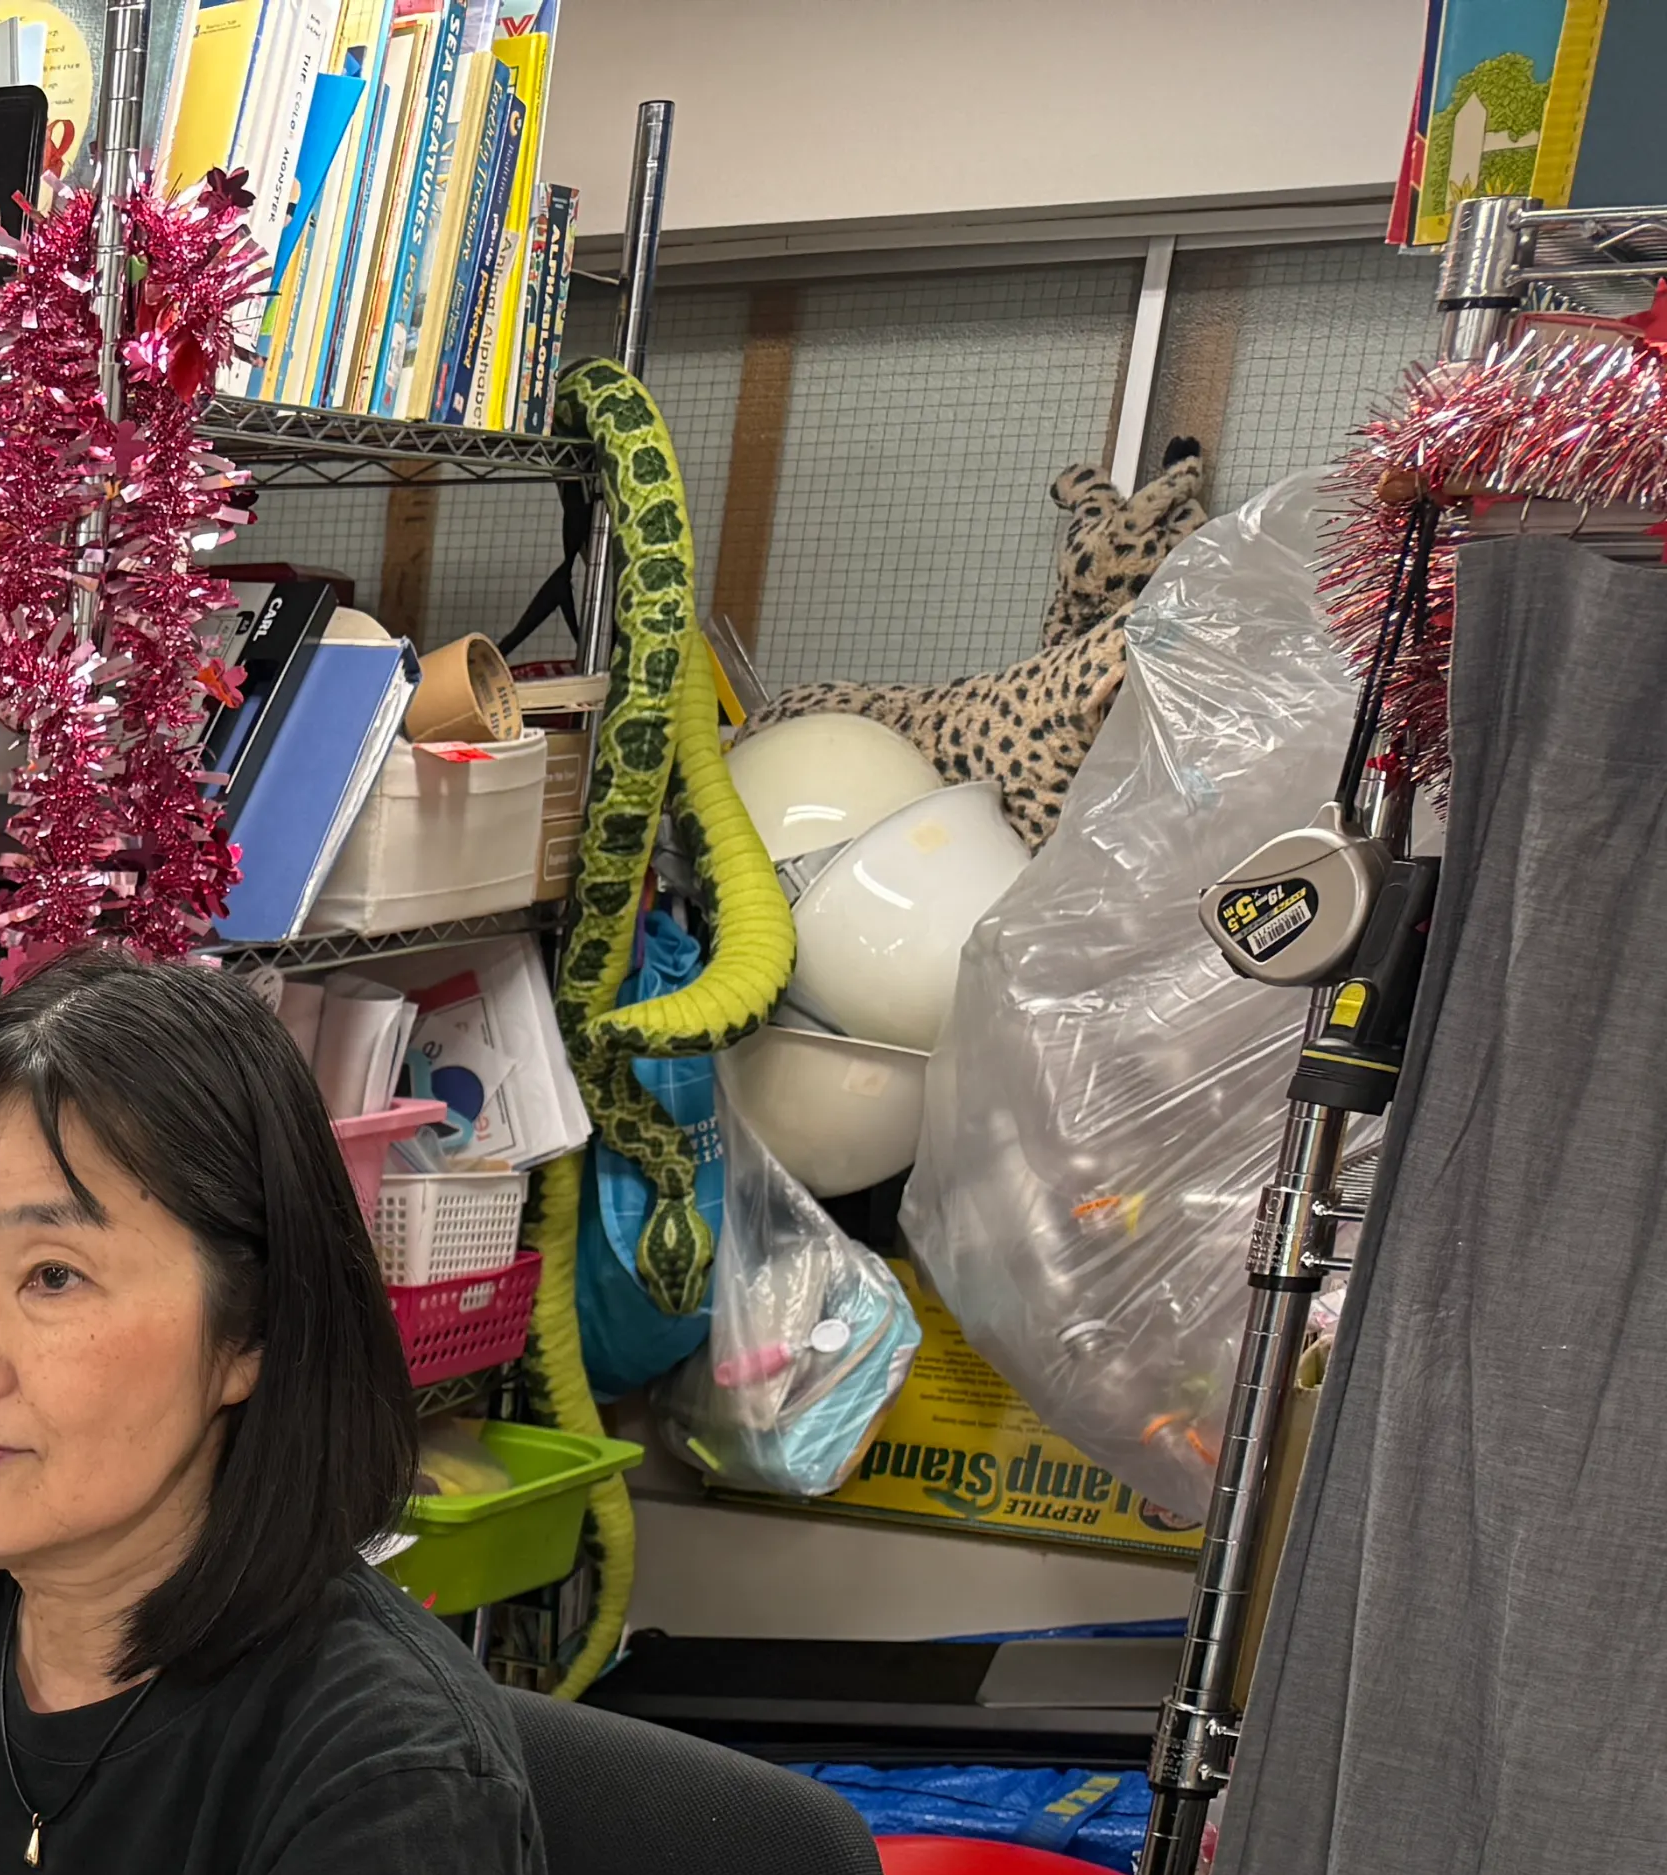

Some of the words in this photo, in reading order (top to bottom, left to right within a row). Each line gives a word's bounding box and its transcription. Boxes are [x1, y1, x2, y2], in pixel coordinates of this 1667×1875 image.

[444, 14, 460, 72] SEA
[303, 54, 312, 85] THE
[268, 147, 291, 223] MONSTER
[411, 80, 448, 246] CREATURES
[253, 597, 283, 642] CARL
[1267, 884, 1286, 906] 19
[860, 1440, 997, 1497] Stand
[1004, 1498, 1100, 1524] REPTILE
